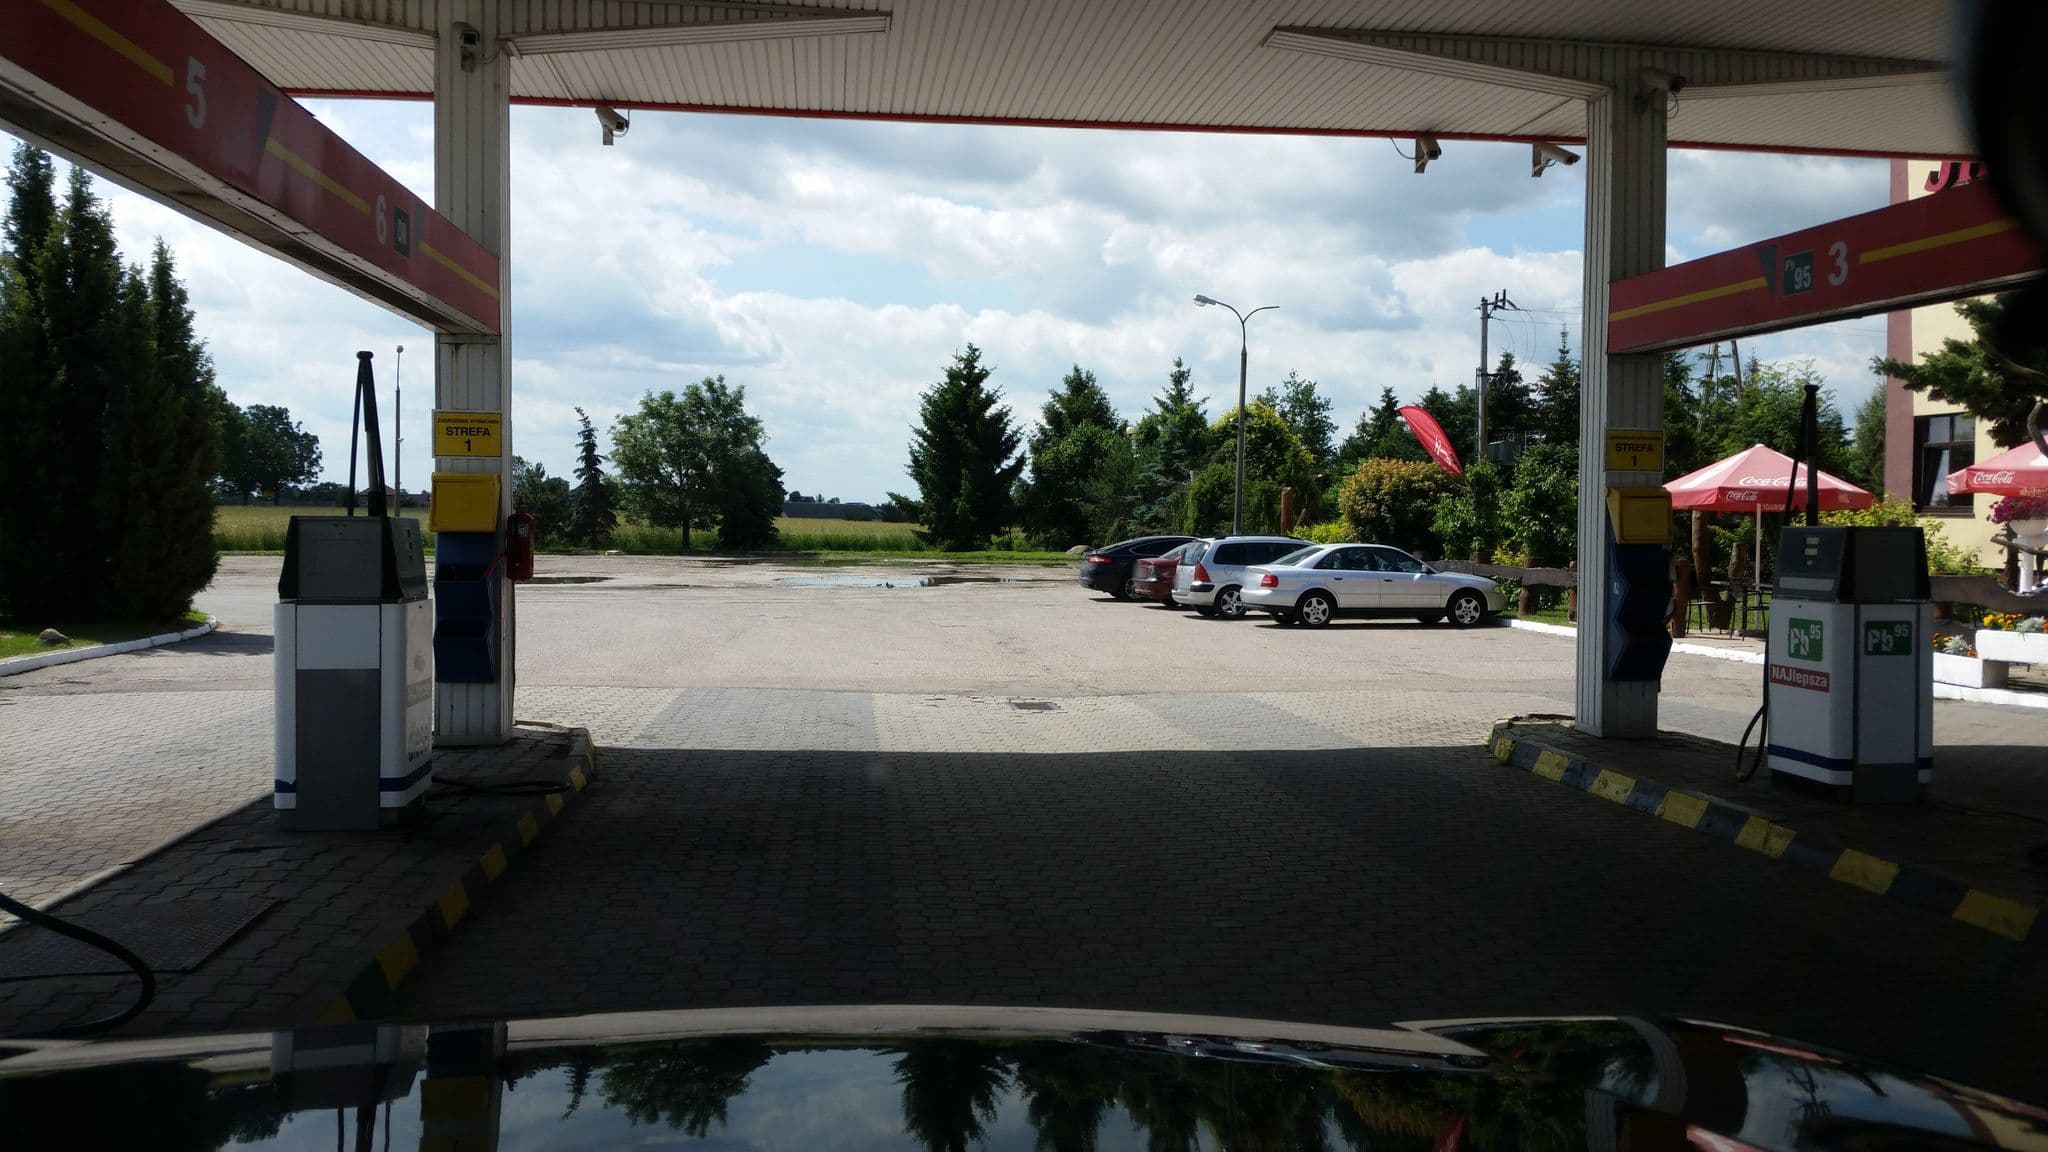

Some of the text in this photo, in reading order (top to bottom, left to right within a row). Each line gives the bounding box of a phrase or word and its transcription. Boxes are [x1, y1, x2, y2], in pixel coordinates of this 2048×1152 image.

[185, 56, 206, 129] 5
[375, 194, 388, 246] 6
[1794, 240, 1849, 290] 95 3
[446, 426, 491, 437] STREFA
[464, 438, 471, 452] 1
[1615, 442, 1654, 452] STREFA
[1631, 455, 1637, 467] 1
[1973, 470, 2016, 485] Coca-Cola
[1789, 624, 1822, 657] Pb 95
[1867, 624, 1910, 653] Pb 95
[1771, 665, 1828, 689] NAJlepsza
